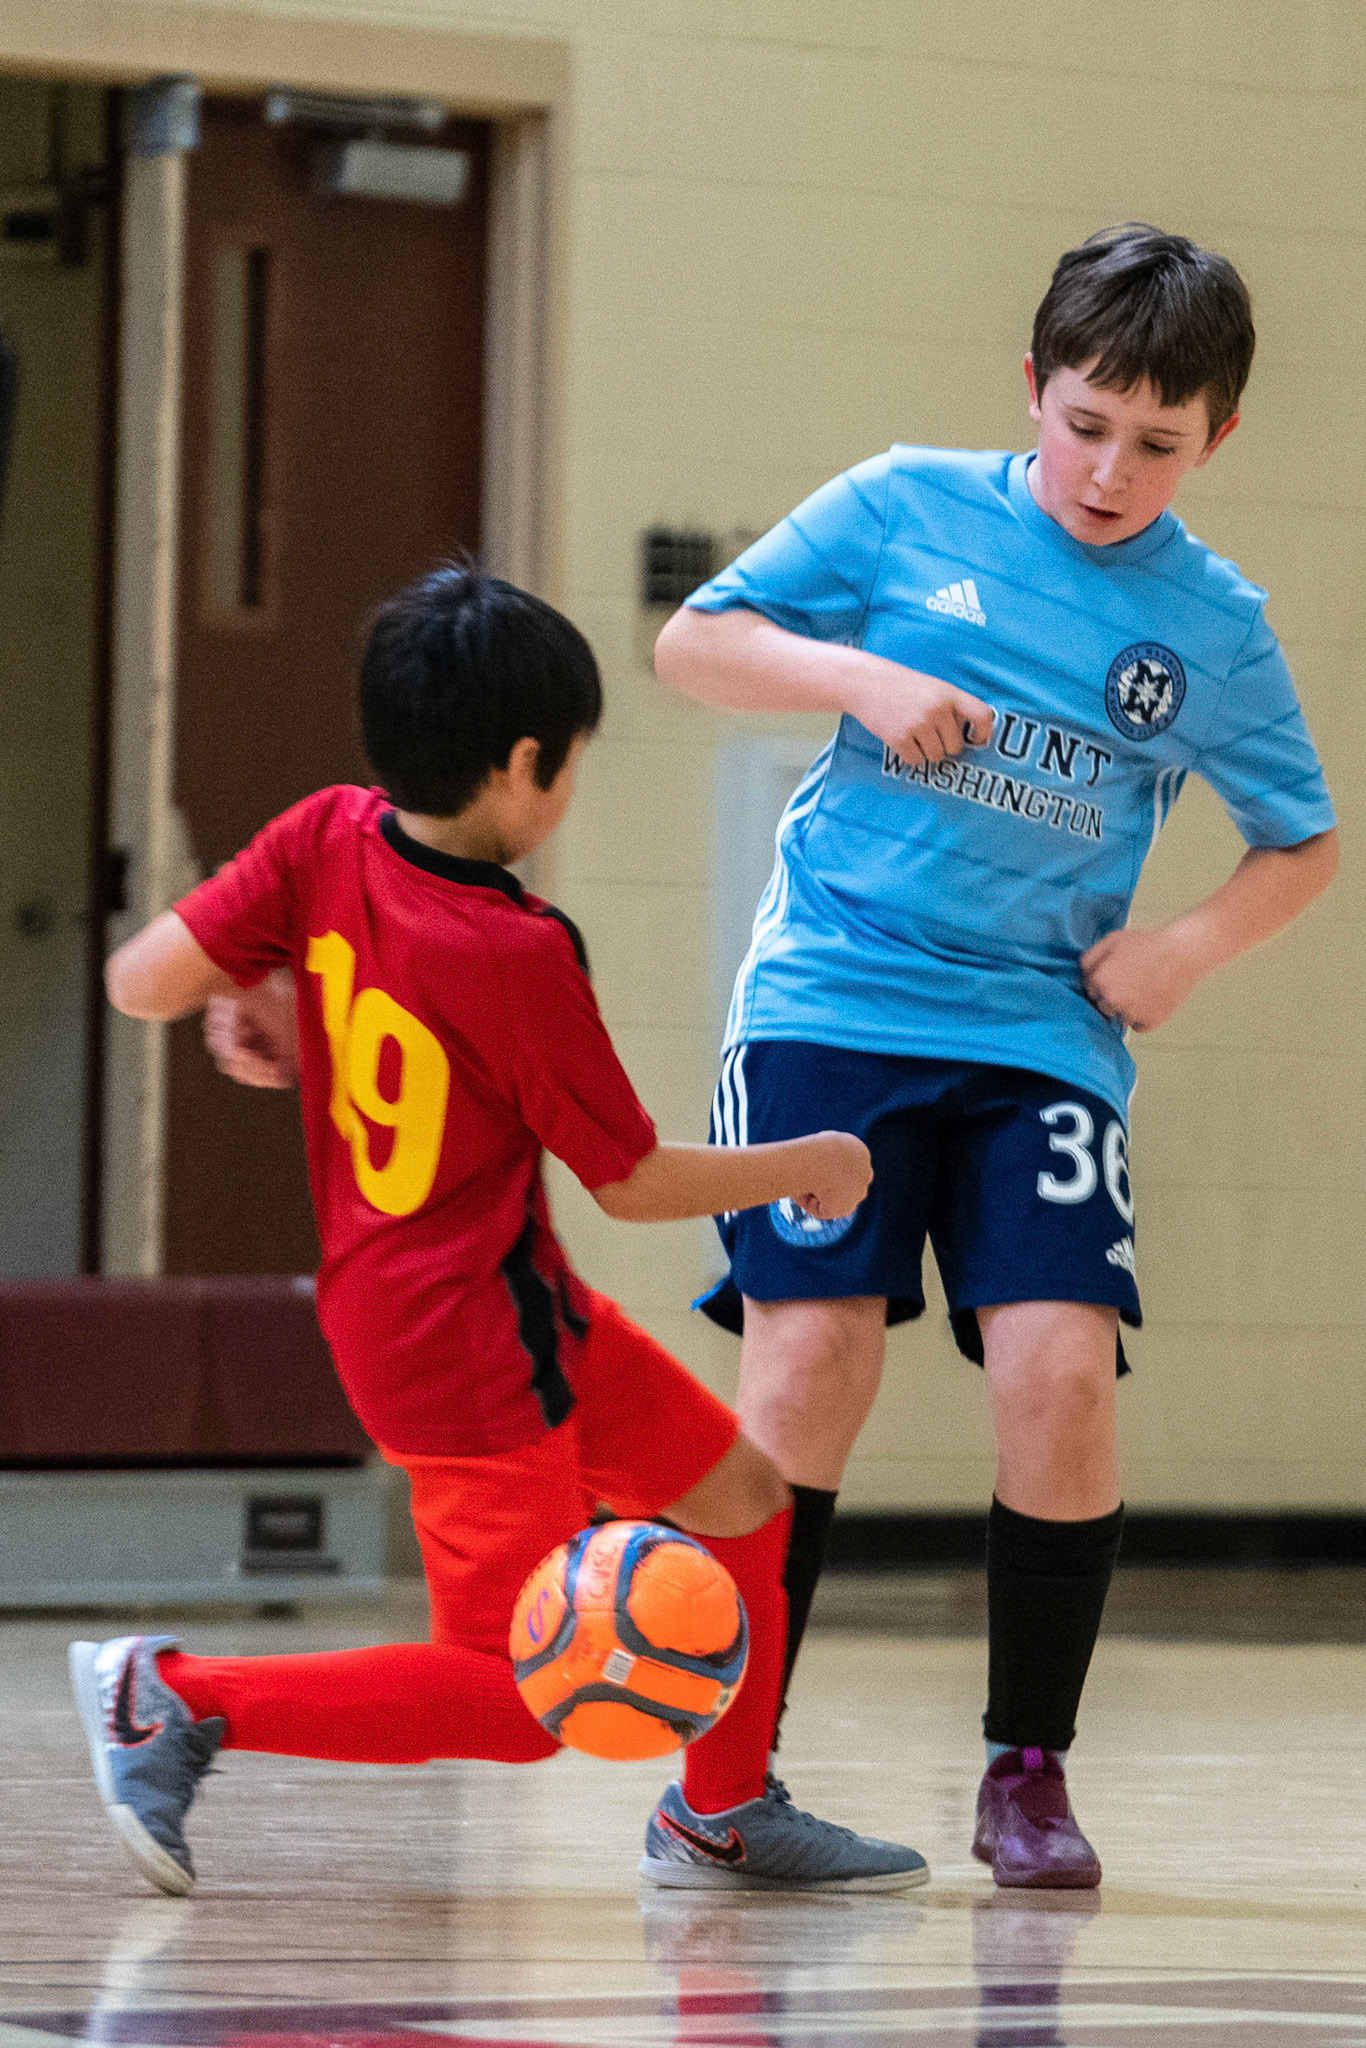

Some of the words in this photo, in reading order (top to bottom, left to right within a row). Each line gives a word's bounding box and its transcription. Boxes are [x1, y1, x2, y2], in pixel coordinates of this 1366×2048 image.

[925, 596, 987, 627] adidas
[961, 706, 1112, 791] UNT
[304, 929, 451, 1217] 19
[1036, 1100, 1136, 1228] 36
